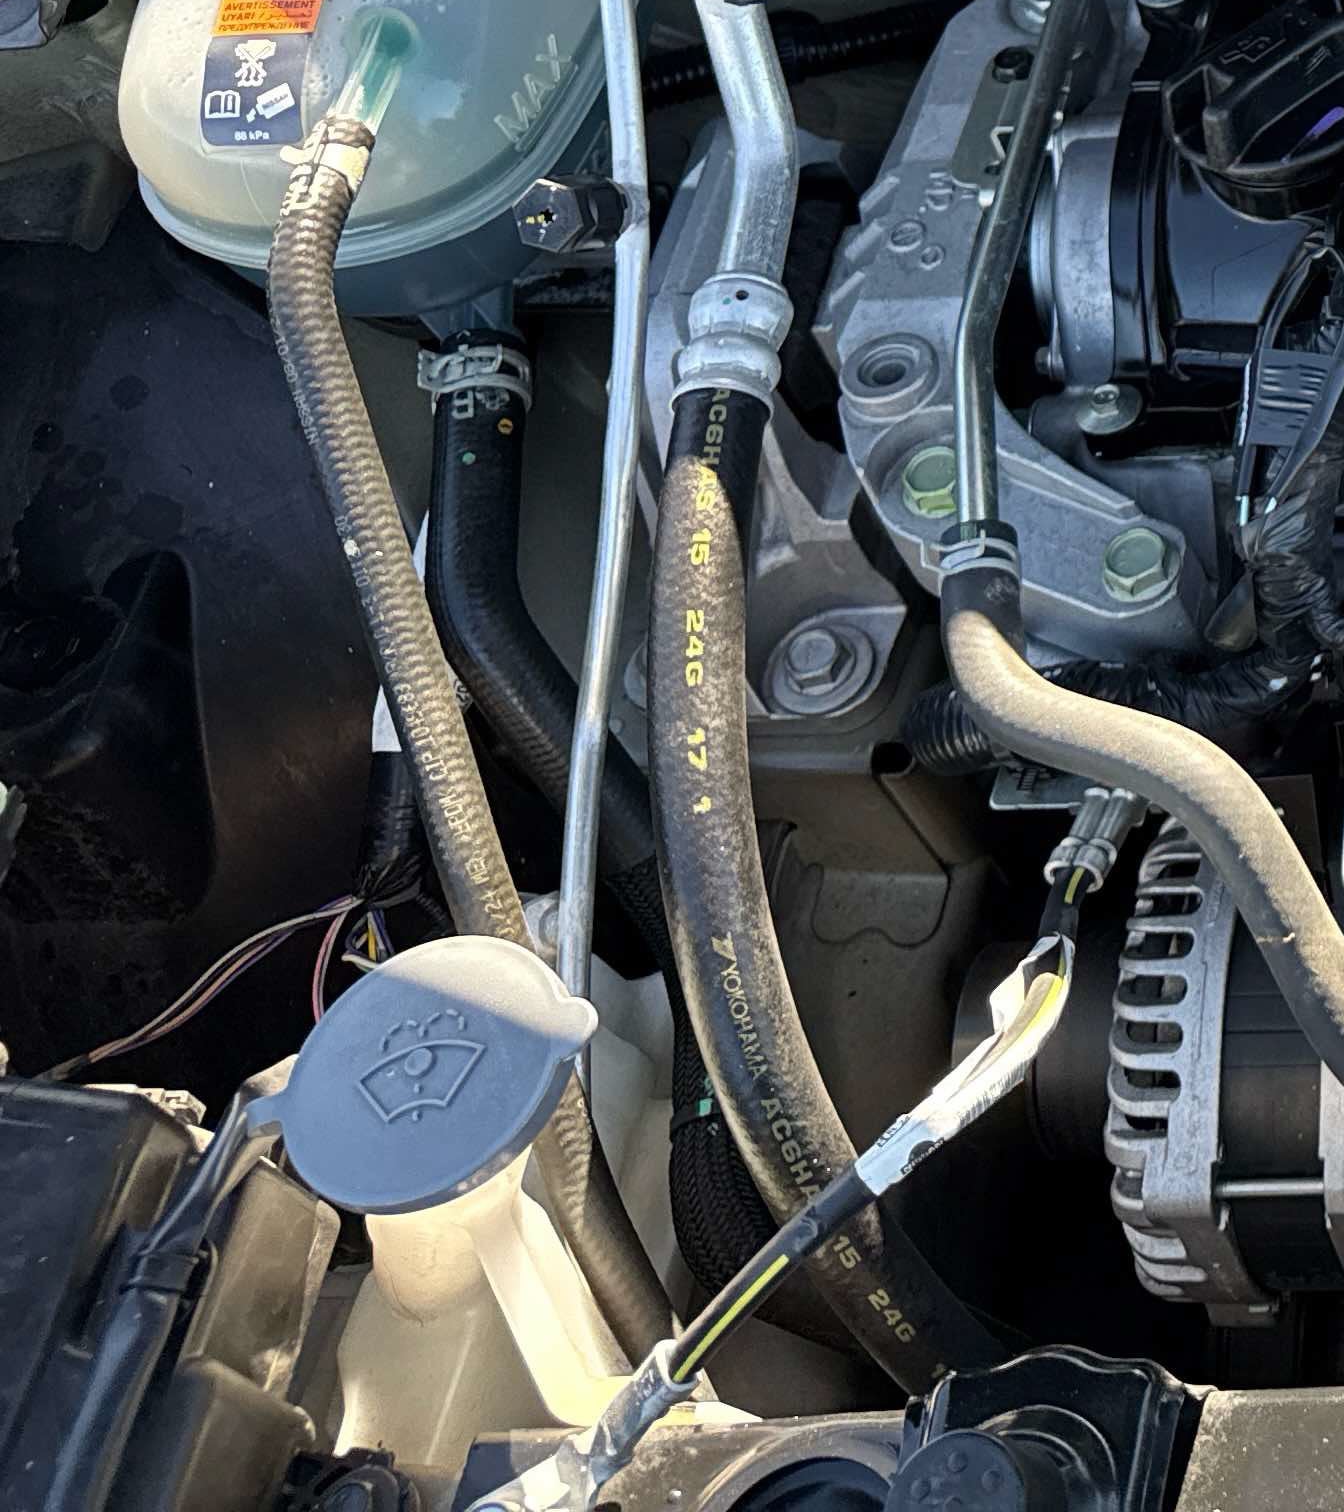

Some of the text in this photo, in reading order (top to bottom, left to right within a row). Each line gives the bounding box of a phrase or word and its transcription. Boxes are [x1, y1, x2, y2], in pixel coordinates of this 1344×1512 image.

[224, 0, 317, 11] AVERTISSEMENT
[494, 34, 572, 142] MAX
[249, 130, 270, 141] kPa
[688, 532, 711, 567] 15
[687, 727, 709, 772] 17
[716, 963, 768, 1081] YOKOHAMA
[832, 1235, 862, 1270] 15
